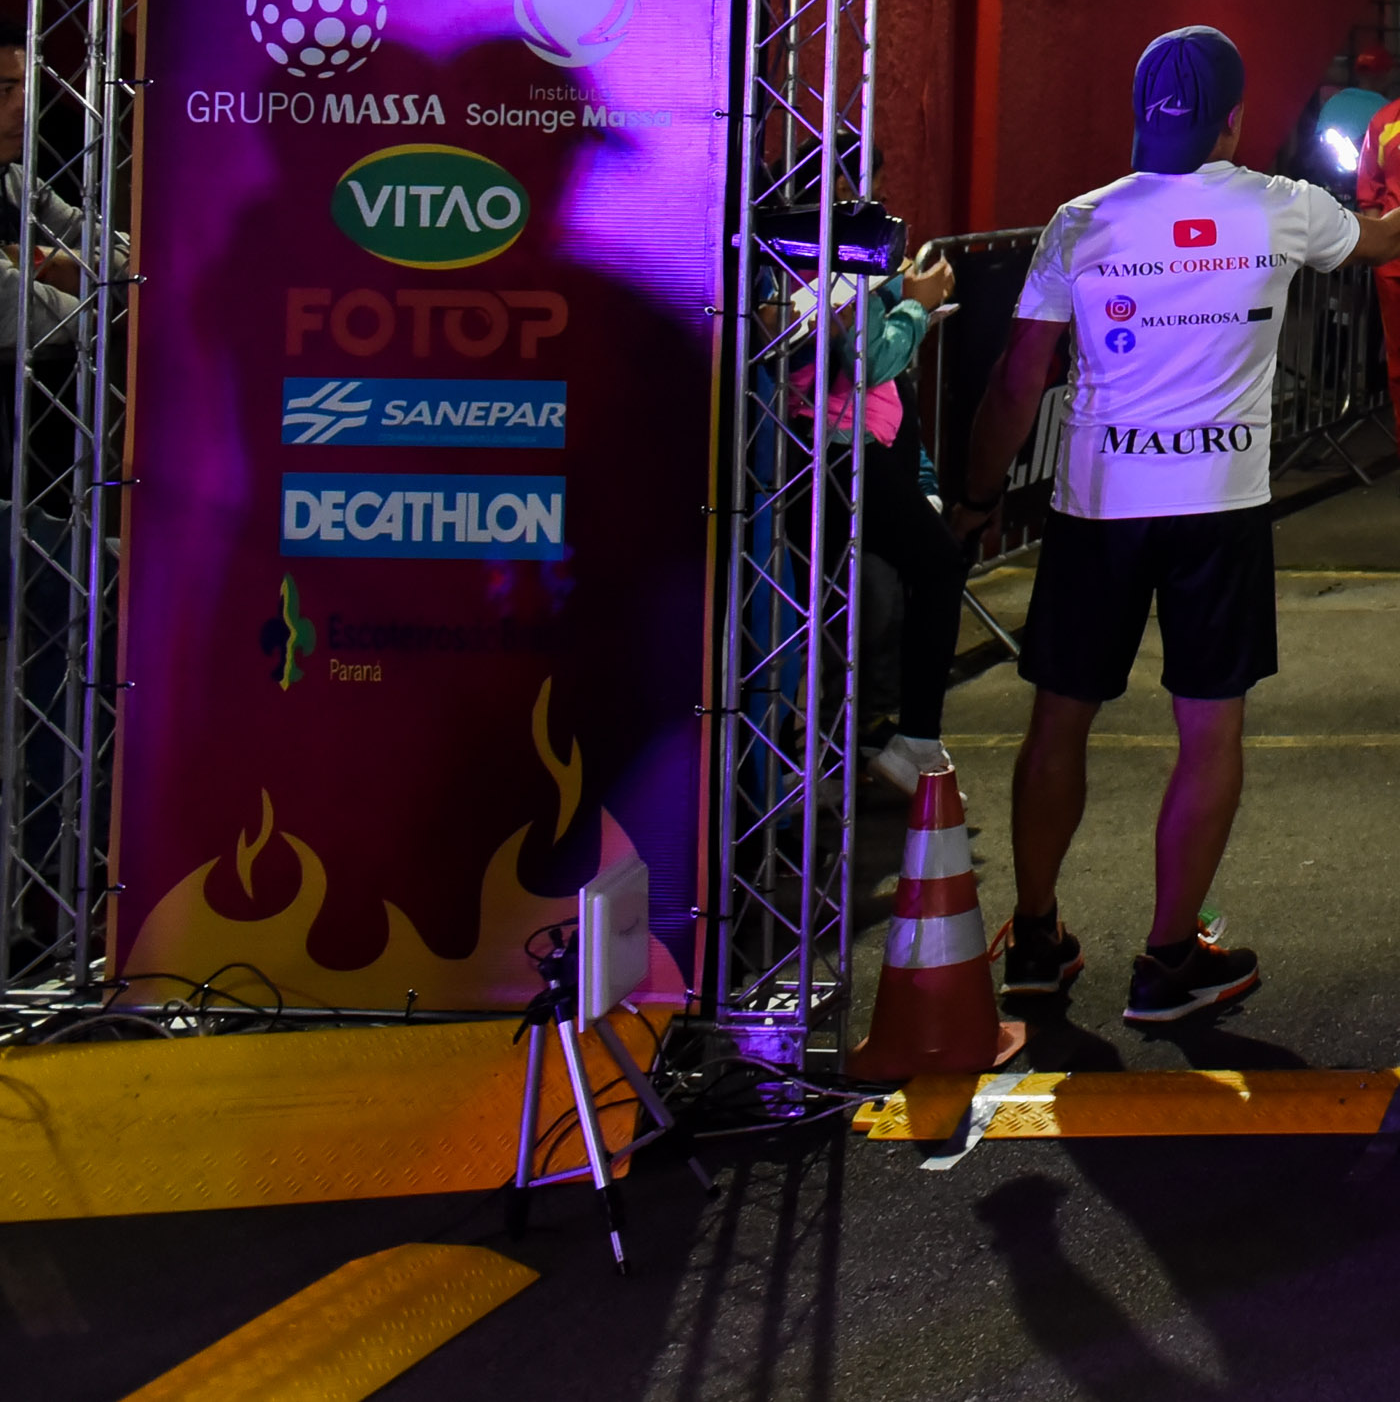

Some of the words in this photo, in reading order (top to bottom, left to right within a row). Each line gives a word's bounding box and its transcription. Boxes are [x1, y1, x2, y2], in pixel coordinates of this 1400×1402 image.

[186, 90, 315, 125] GRUPO
[322, 93, 447, 126] MASSA
[465, 102, 577, 134] Solange
[582, 104, 673, 128] Massa
[1097, 261, 1164, 277] VAMOS
[1169, 256, 1250, 274] CORRER
[1255, 252, 1289, 269] RUN
[284, 286, 569, 360] FOTOP
[380, 399, 567, 428] SANEPAR
[1100, 423, 1253, 455] MAURO
[283, 489, 563, 544] DECATHLON
[328, 657, 383, 684] Paraná
